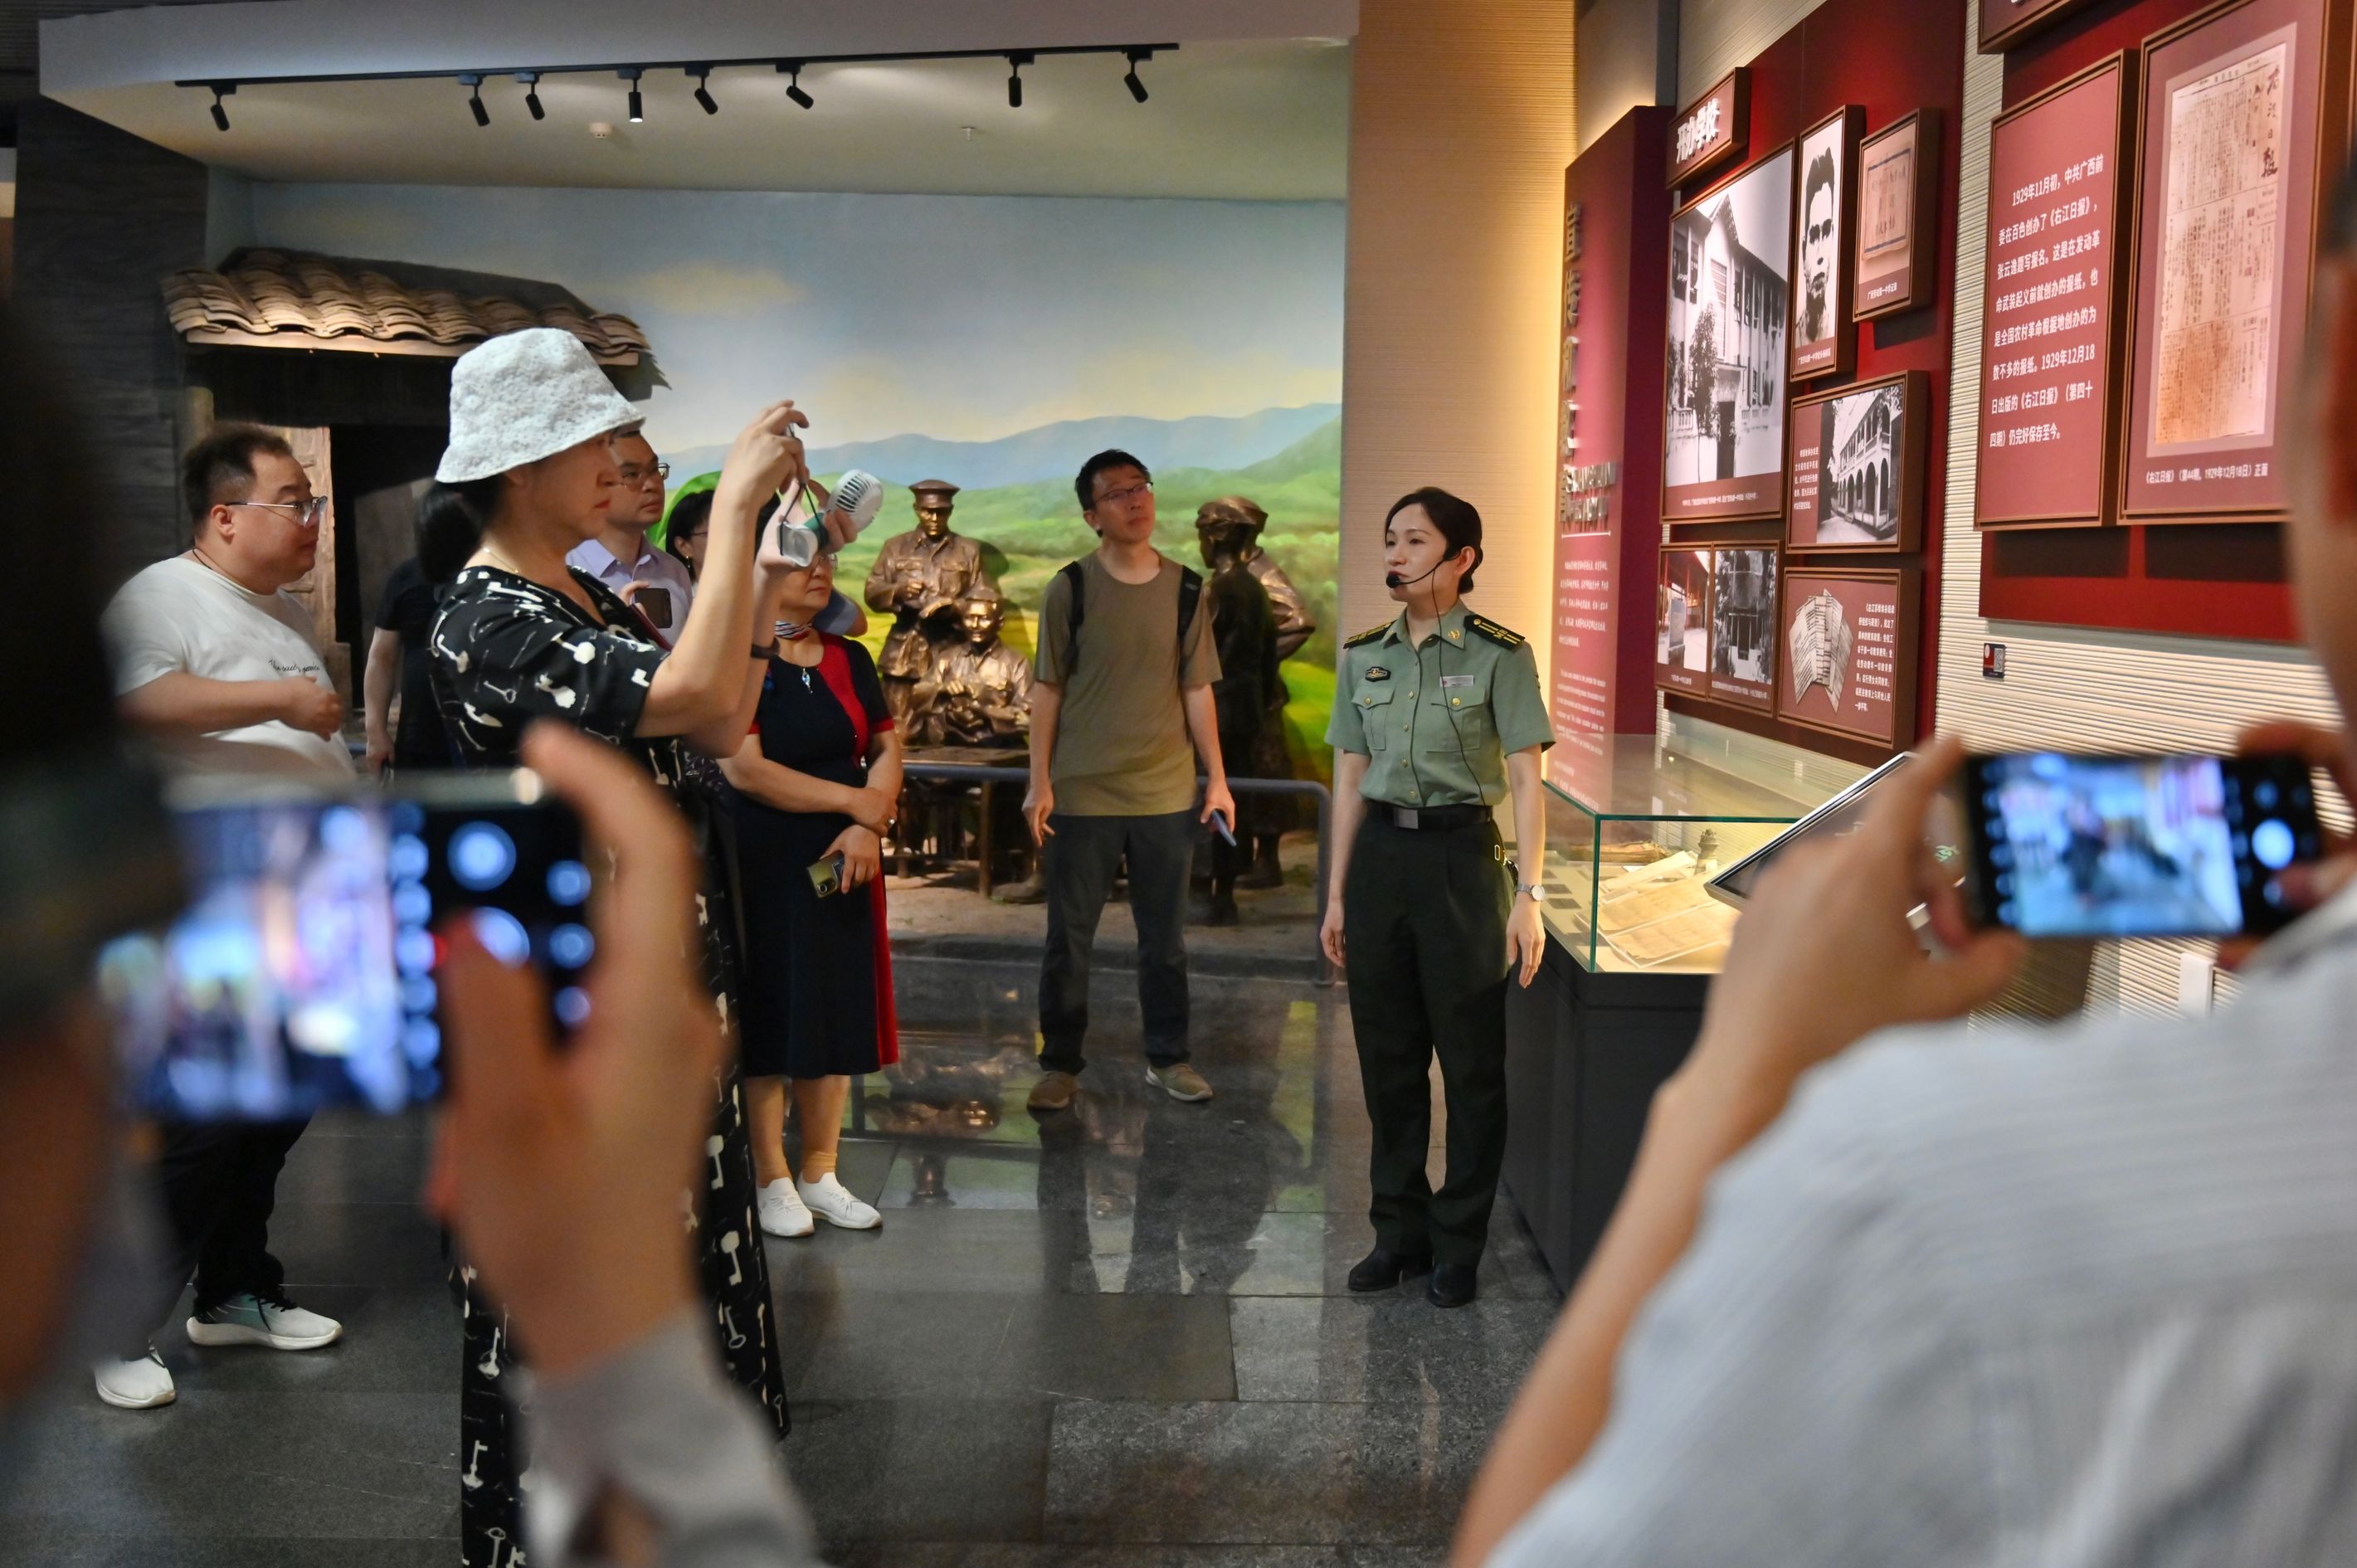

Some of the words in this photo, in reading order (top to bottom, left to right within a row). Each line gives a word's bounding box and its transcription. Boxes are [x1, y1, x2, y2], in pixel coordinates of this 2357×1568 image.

[1676, 98, 1721, 164] 开办学校
[2012, 153, 2104, 207] 1929年11月初，中共广西前
[1998, 196, 2098, 246] 委在百色创办了《右江日报》，
[1997, 230, 2101, 280] 张云逸题写报名。这是在发动革
[1994, 267, 2099, 313] 命武装起义前就创办的报纸，也
[1994, 305, 2096, 348] 是全国农村革命根据地创办的为
[1992, 343, 2096, 382] 数不多的报纸。1929年12月18
